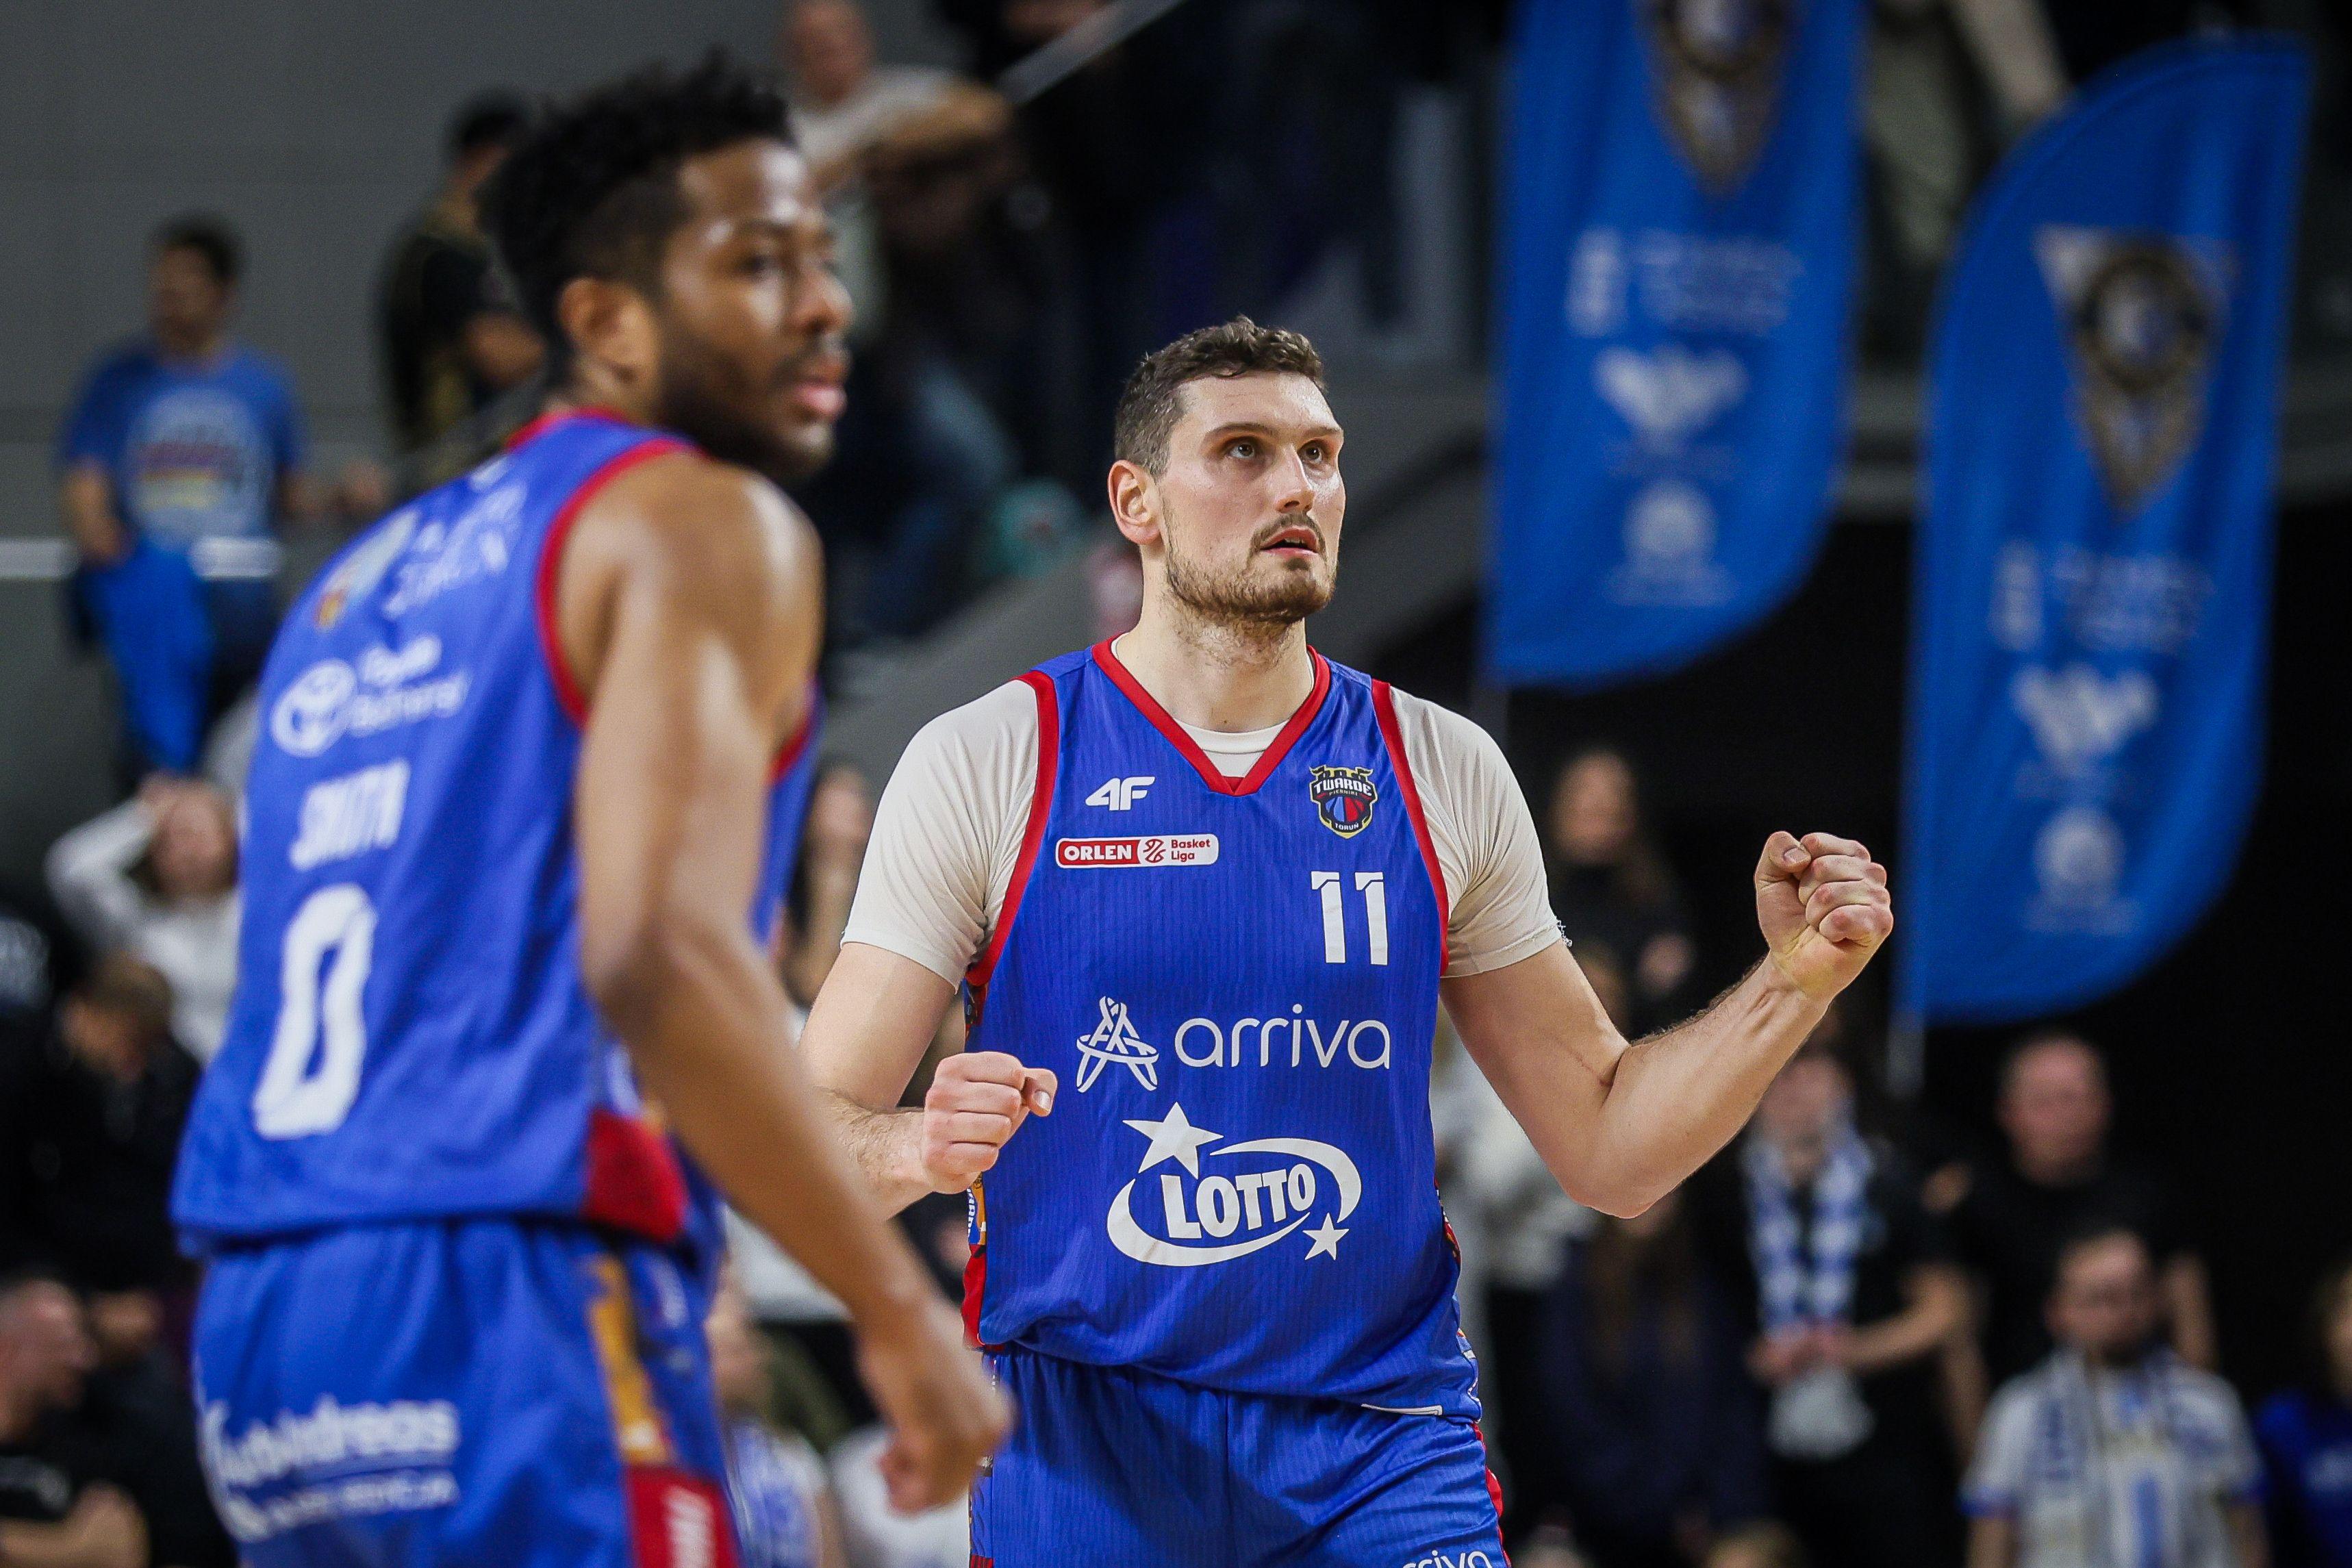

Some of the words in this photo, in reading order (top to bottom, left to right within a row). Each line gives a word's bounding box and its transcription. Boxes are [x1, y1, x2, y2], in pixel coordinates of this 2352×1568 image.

[1085, 776, 1156, 811] 4F
[1313, 777, 1372, 796] TWARDE
[1063, 844, 1132, 861] ORLEN
[1171, 839, 1211, 849] Basket
[1171, 850, 1196, 863] Liga
[1311, 870, 1388, 966] 11
[253, 883, 378, 1140] 0
[1174, 1003, 1391, 1070] arriva
[1161, 1163, 1317, 1239] LOTTO
